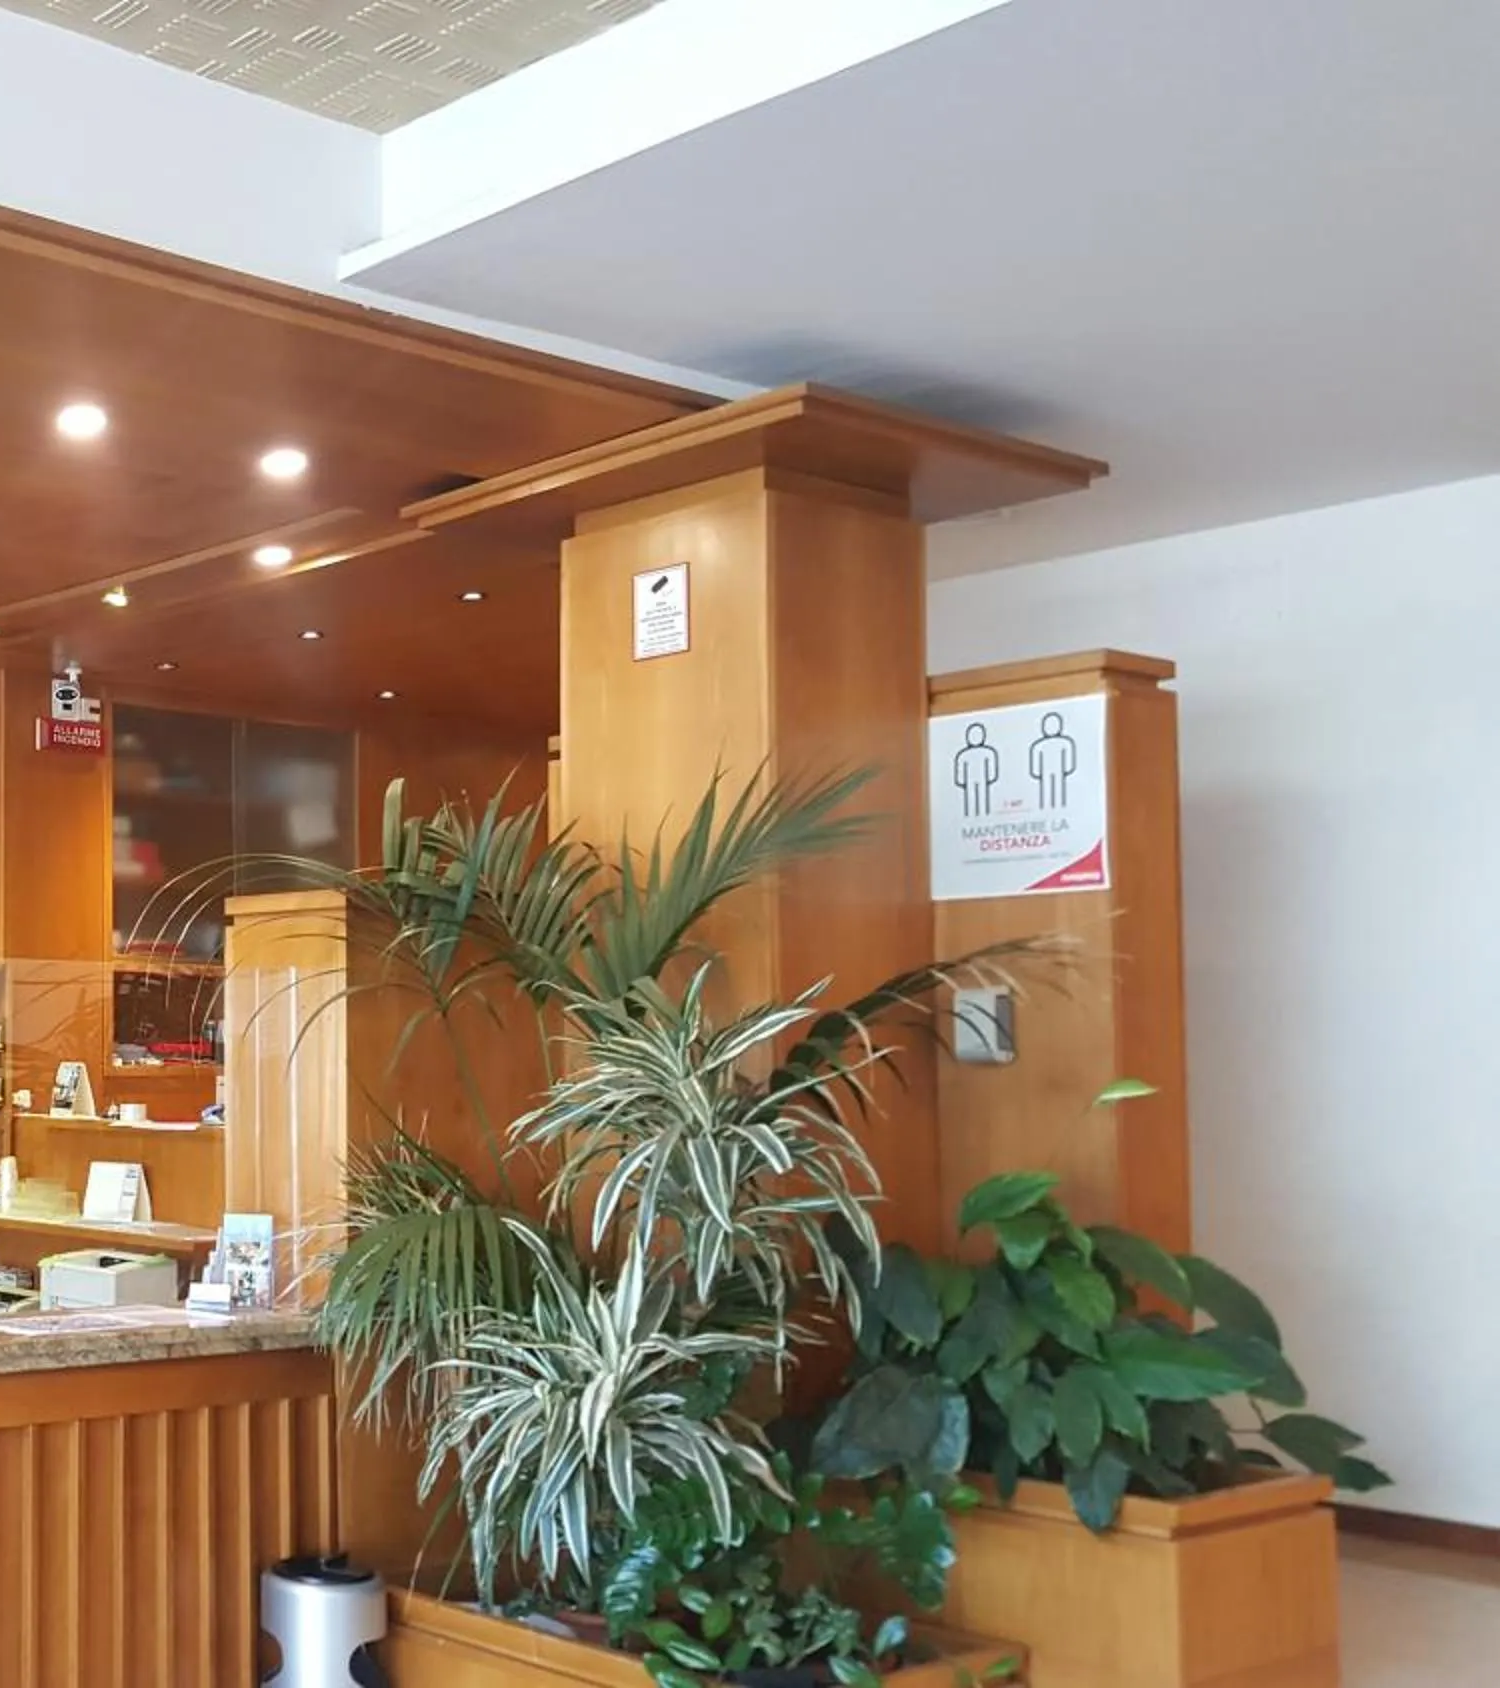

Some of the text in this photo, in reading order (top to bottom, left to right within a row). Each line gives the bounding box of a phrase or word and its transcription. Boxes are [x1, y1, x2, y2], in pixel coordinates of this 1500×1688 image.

[53, 723, 101, 739] ALLARME
[52, 733, 101, 748] INCENDIO
[960, 817, 1070, 839] MANTENERE LA
[979, 834, 1053, 852] DISTANZA
